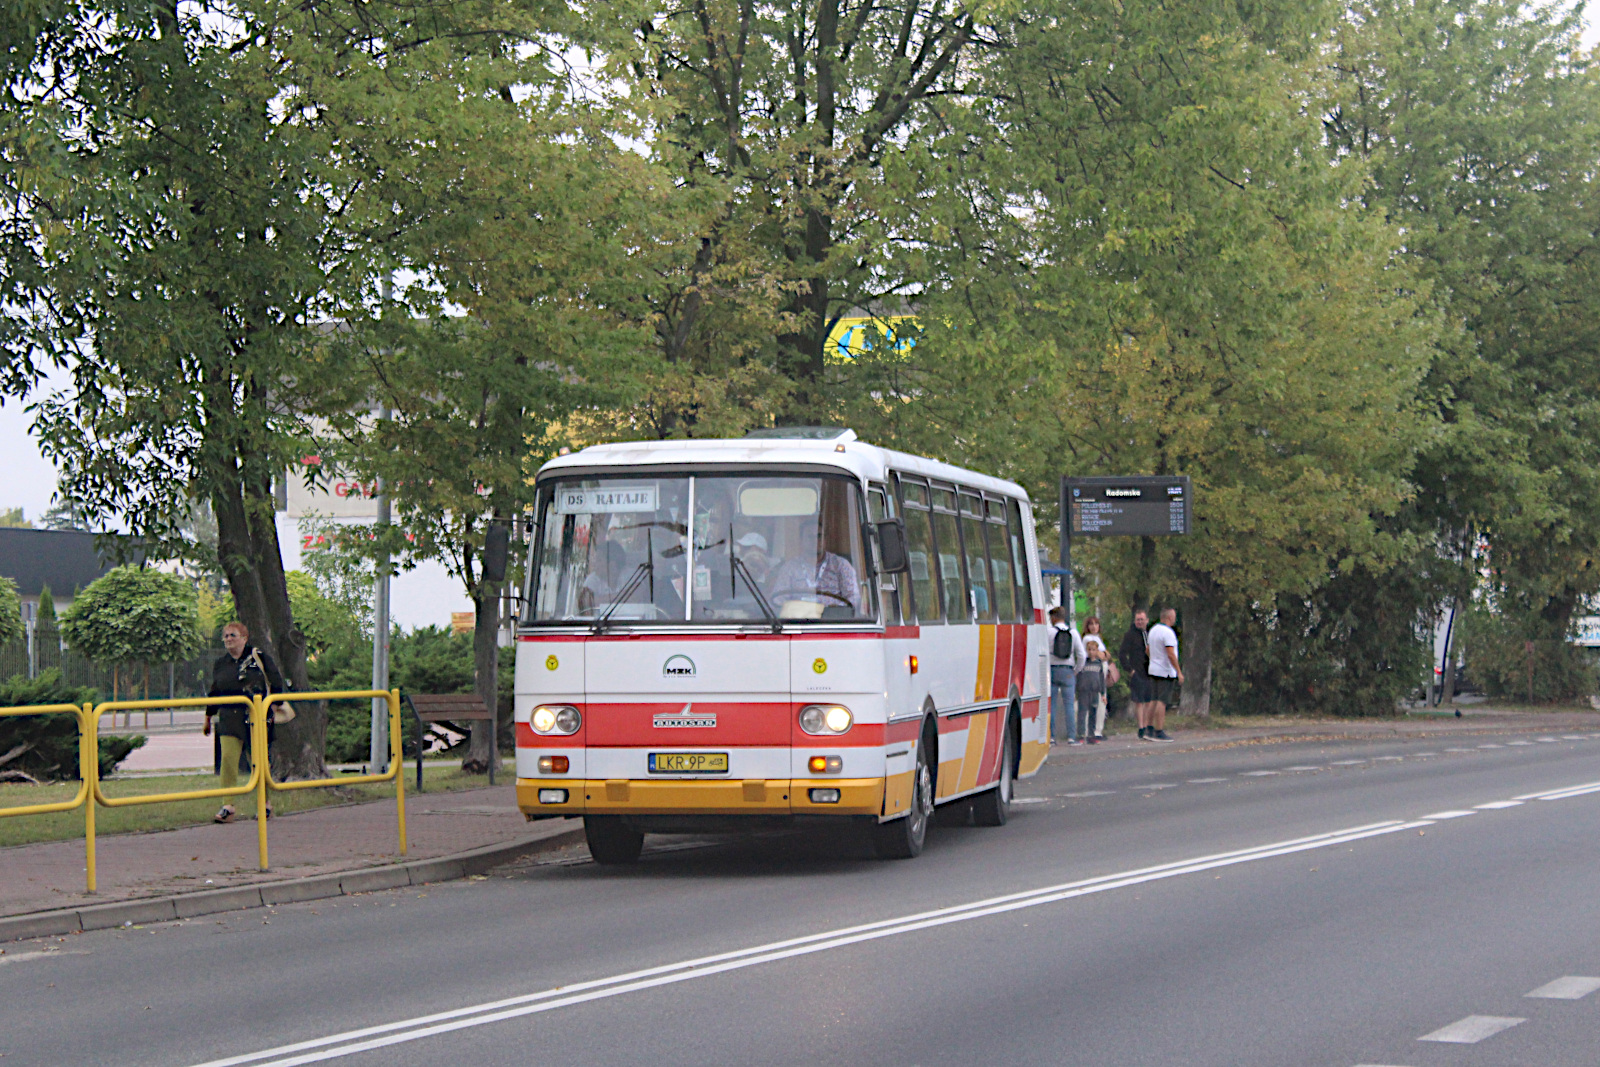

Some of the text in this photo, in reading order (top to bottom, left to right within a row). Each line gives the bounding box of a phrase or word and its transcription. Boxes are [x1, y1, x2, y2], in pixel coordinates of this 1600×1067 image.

[1106, 489, 1141, 497] Radomska
[567, 493, 649, 505] DS RATAJE
[655, 719, 714, 727] AUTOSAN
[658, 755, 706, 769] LKR 9P
